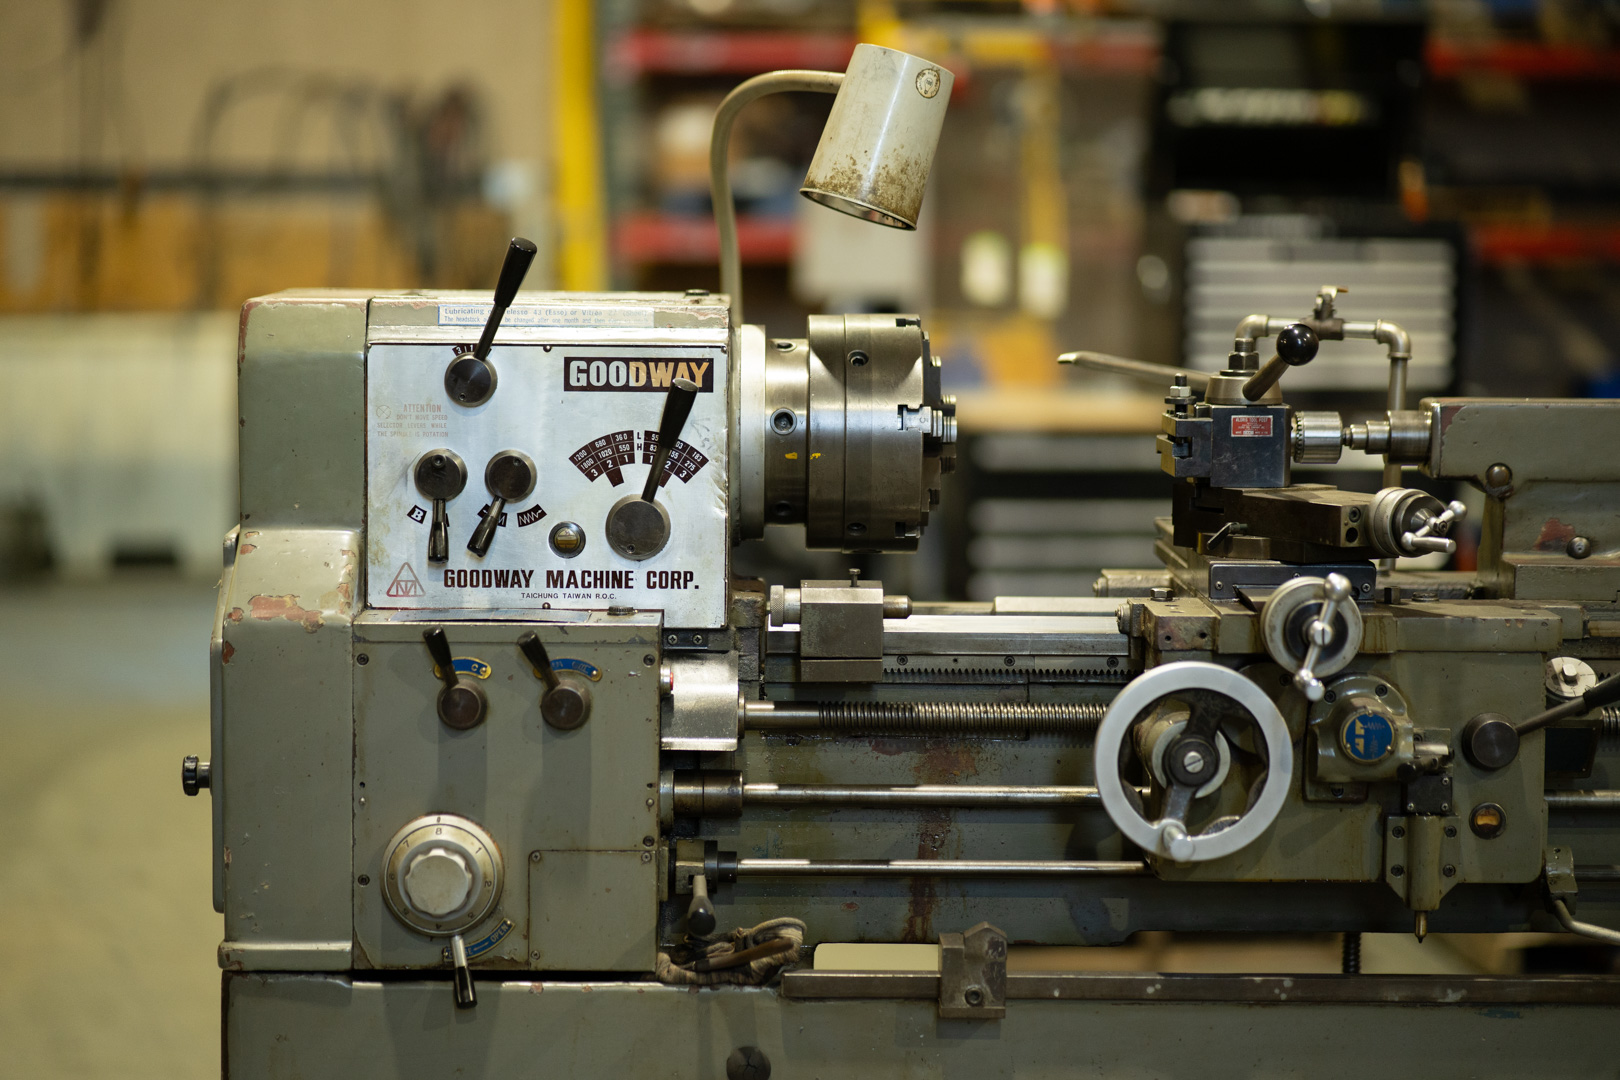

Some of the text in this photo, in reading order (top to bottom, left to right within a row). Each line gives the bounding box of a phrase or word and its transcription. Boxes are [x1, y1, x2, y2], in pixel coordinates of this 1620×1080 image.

[569, 360, 710, 388] GOODWAY
[404, 404, 441, 412] ATTENTION
[574, 450, 587, 462] 1200
[598, 449, 612, 458] 1020
[692, 451, 703, 461] 183
[581, 458, 594, 470] 1800
[664, 460, 671, 469] 2
[684, 460, 696, 470] 275
[413, 510, 423, 521] B
[443, 568, 700, 590] GOODWAY MACHINE CORP.
[403, 840, 410, 848] 7
[490, 924, 508, 943] OPEN
